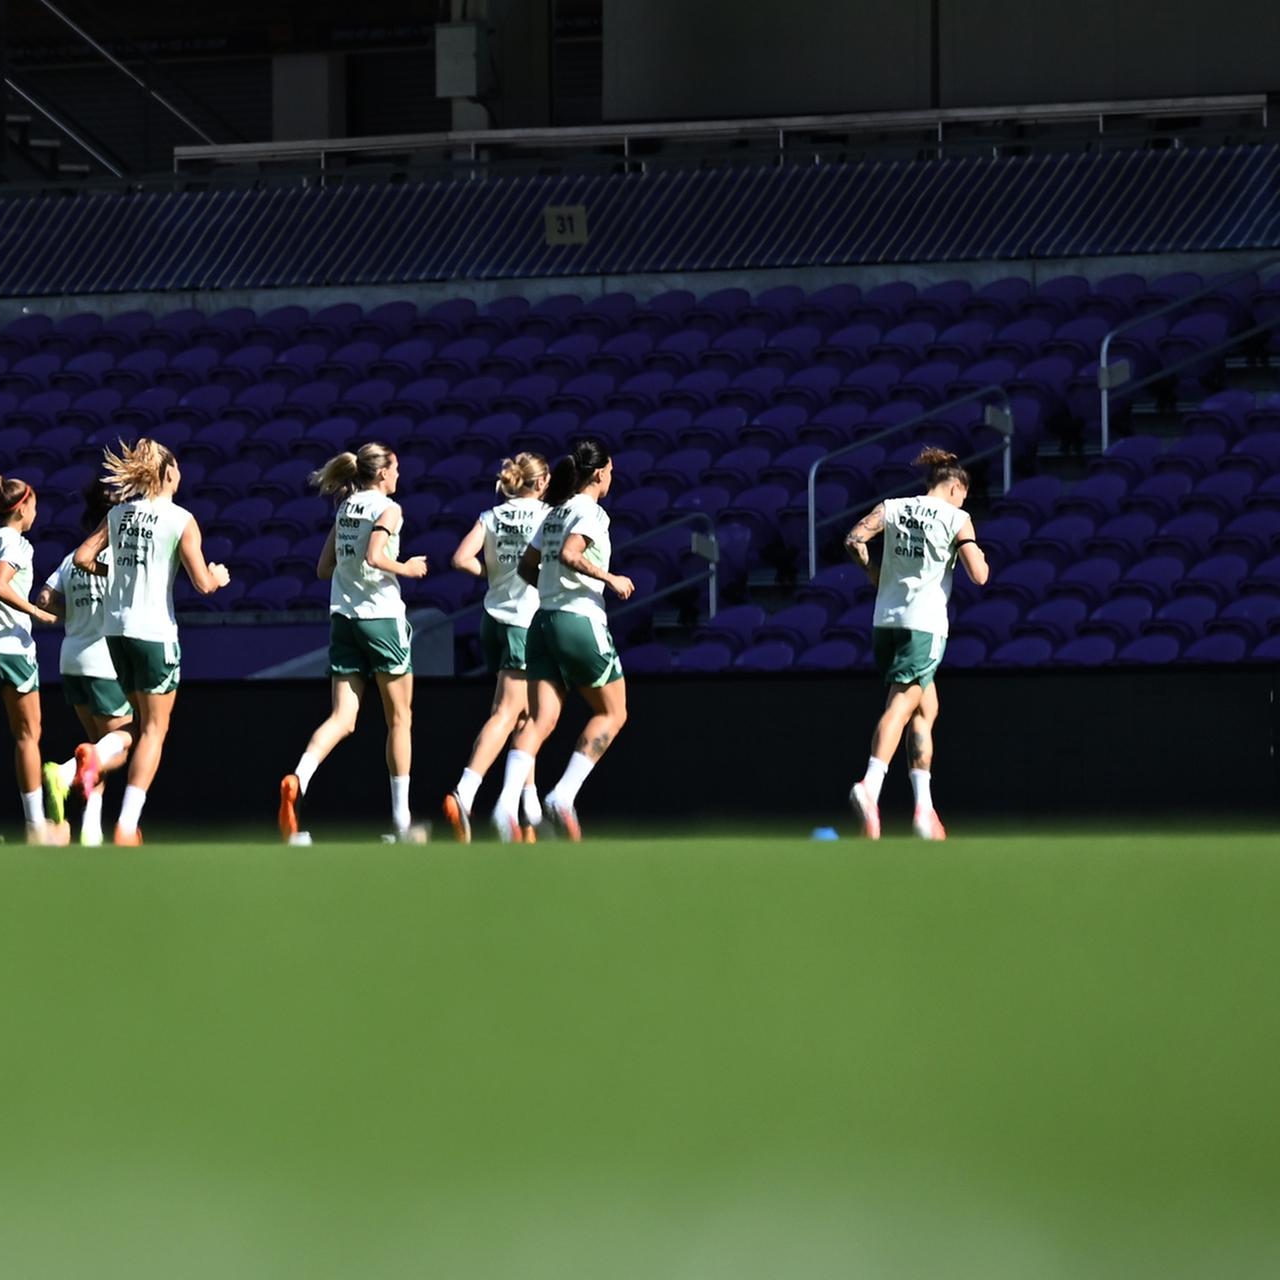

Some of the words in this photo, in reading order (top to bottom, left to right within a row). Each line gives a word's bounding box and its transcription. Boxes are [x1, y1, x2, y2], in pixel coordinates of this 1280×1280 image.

[556, 214, 574, 234] 31
[135, 512, 158, 525] TIM
[511, 510, 534, 520] TIM
[339, 517, 360, 528] oste
[118, 523, 153, 539] Poste
[895, 545, 913, 557] eni
[117, 554, 133, 566] eni
